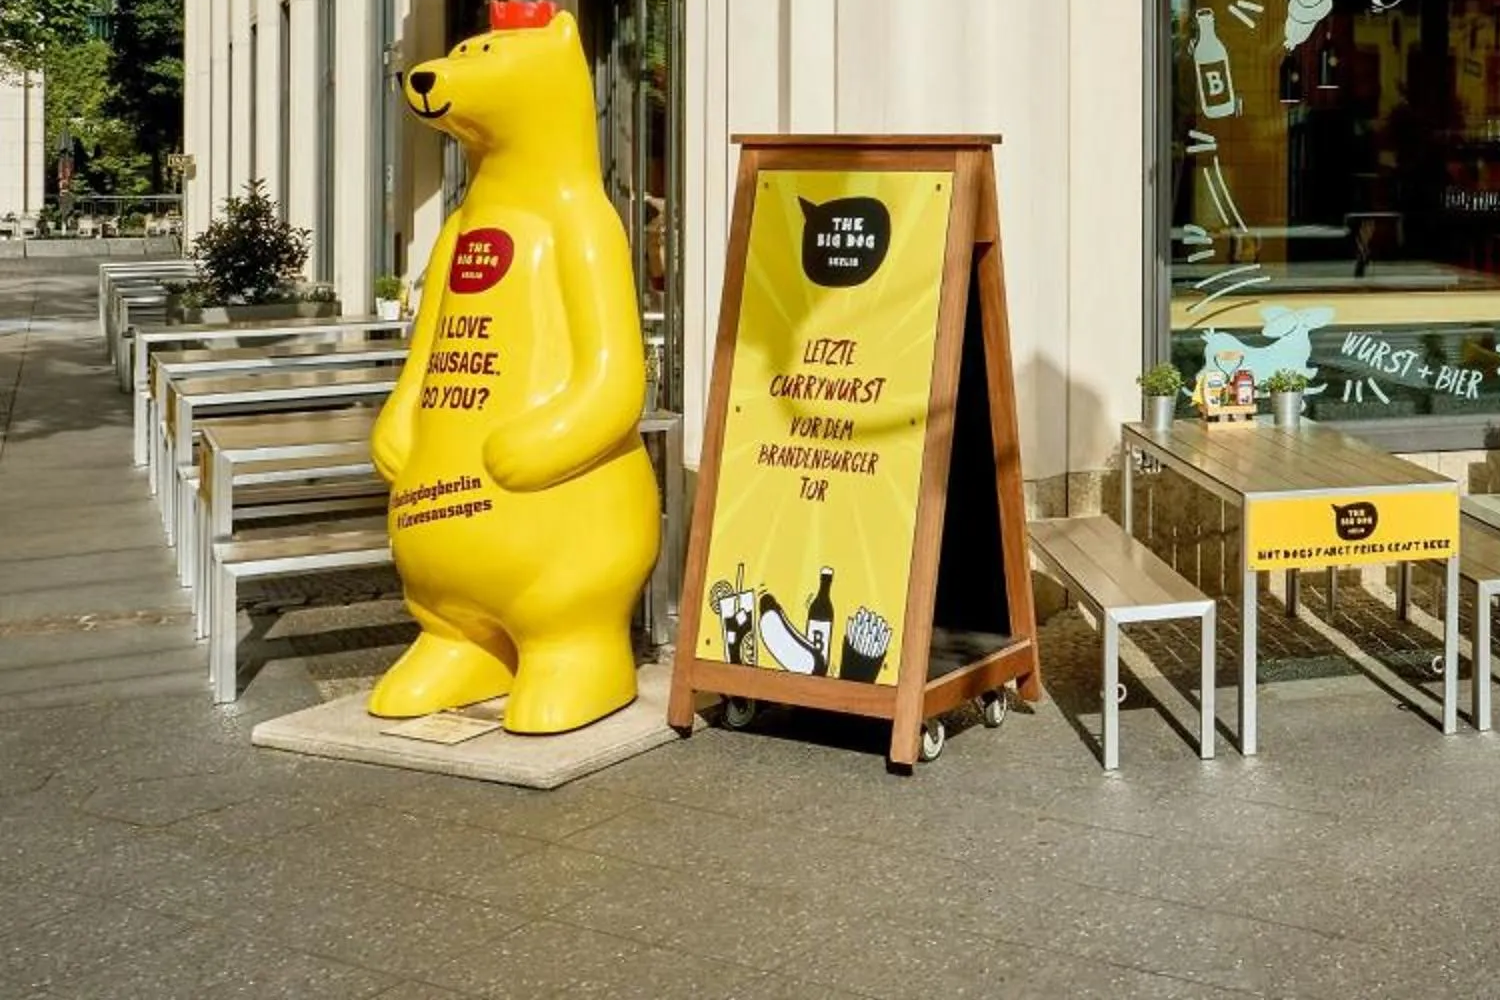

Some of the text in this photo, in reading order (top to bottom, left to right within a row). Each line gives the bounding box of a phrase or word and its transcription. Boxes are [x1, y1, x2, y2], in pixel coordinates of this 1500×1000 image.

[1204, 70, 1226, 96] B
[831, 216, 865, 231] THE
[816, 232, 875, 249] BIG DOG
[447, 315, 493, 339] LOVE
[803, 337, 858, 367] LETZTE
[1341, 330, 1484, 400] WURST + BIER
[439, 385, 491, 411] YOU?
[769, 373, 887, 404] CURRYWURST
[790, 415, 856, 441] VOR DEM
[757, 442, 880, 477] BRANDENBURGER
[800, 474, 830, 503] TOR
[812, 629, 826, 651] B
